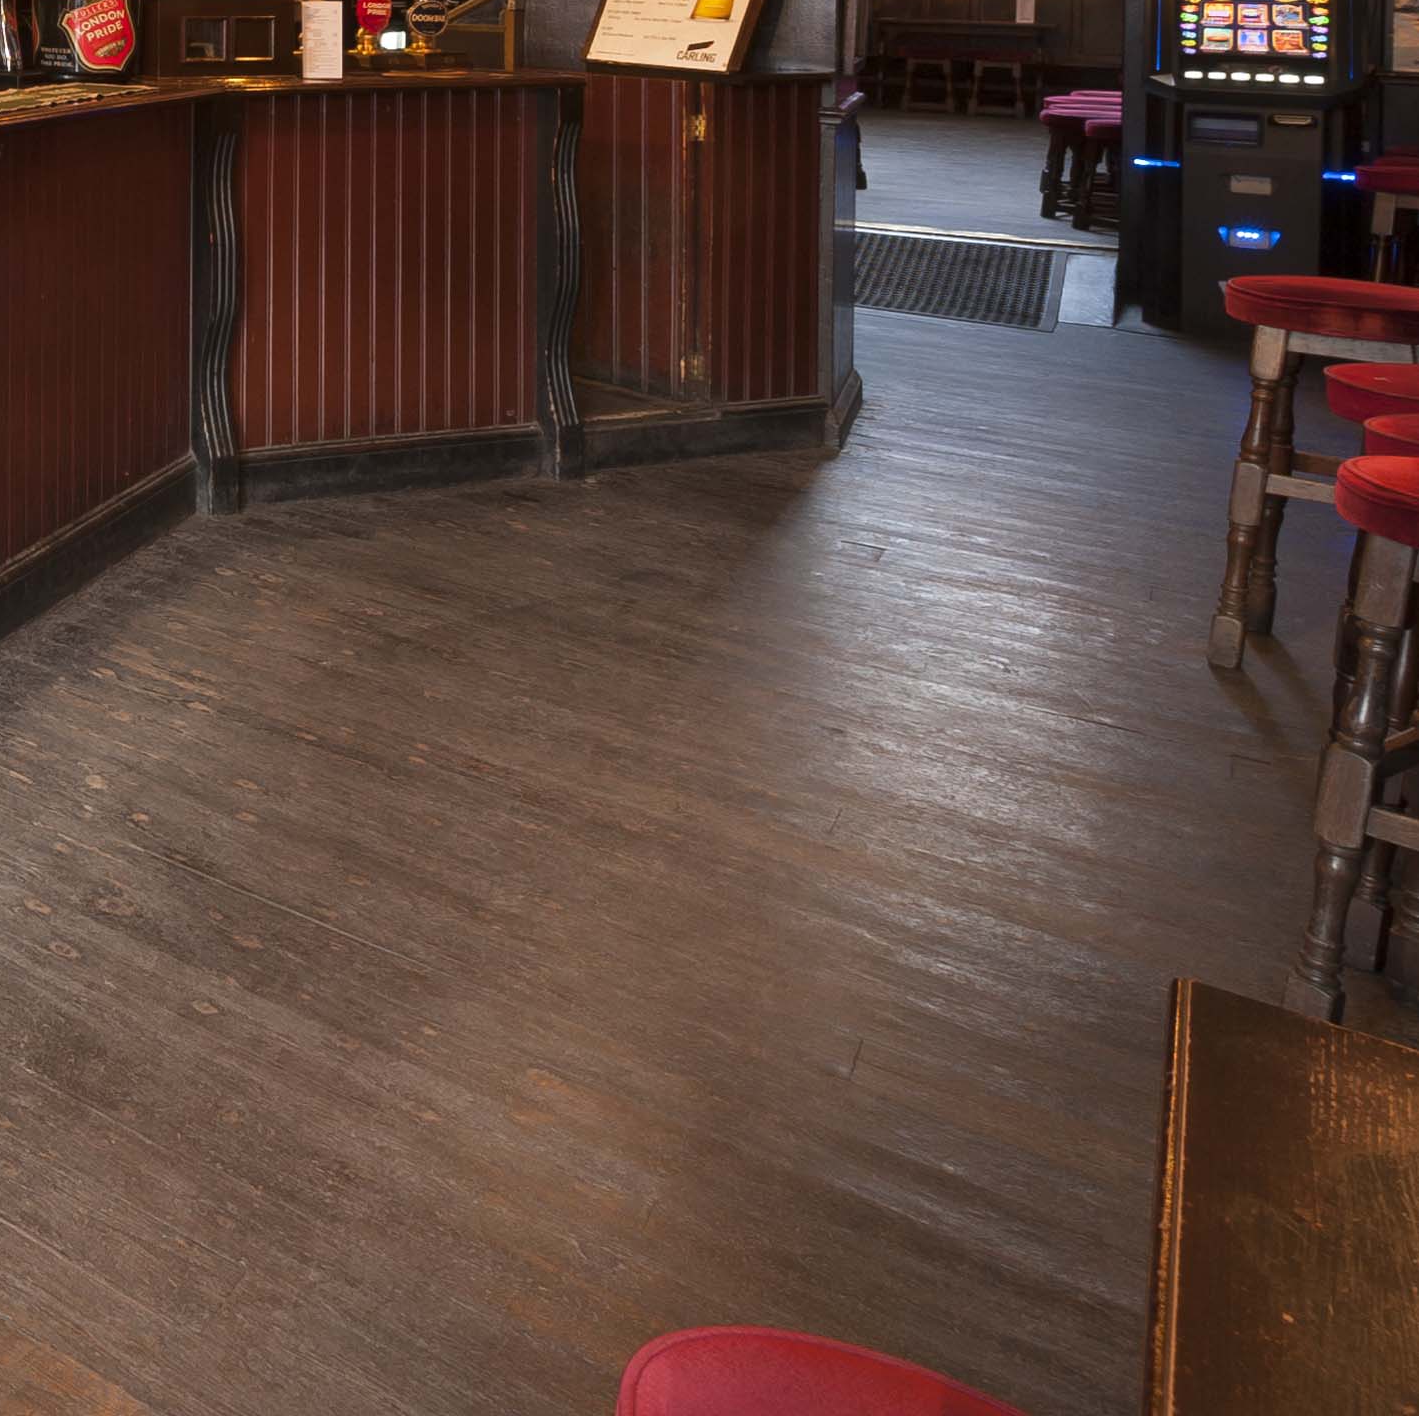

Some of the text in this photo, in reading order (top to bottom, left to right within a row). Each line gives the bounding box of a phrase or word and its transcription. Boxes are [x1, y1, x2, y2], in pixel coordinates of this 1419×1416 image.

[75, 8, 125, 35] LONDON
[85, 22, 124, 43] PRIDE
[676, 50, 718, 63] CARLING
